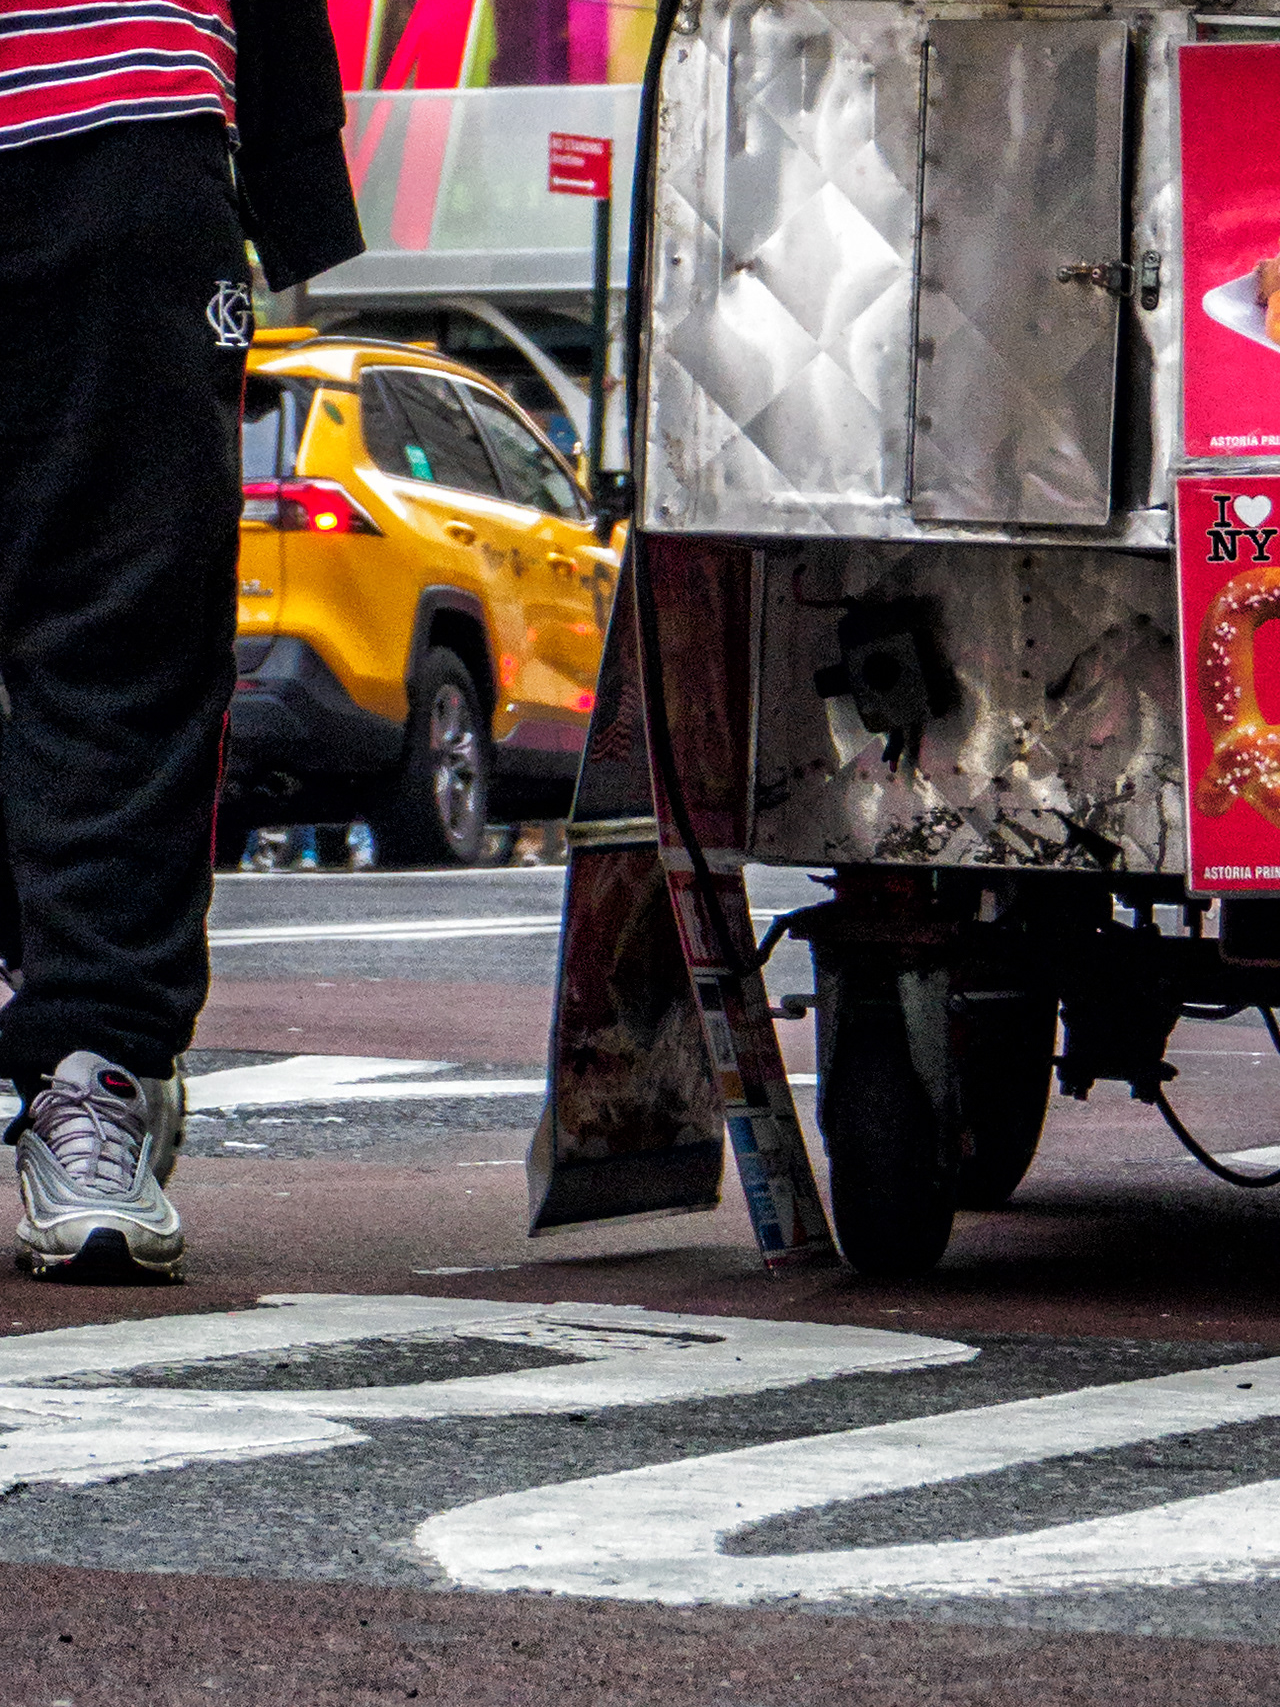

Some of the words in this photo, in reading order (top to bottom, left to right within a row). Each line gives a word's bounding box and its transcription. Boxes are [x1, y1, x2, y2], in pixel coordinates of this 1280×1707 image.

[1213, 495, 1231, 527] I
[1206, 529, 1277, 563] NY
[1204, 865, 1252, 879] ASTORIA
